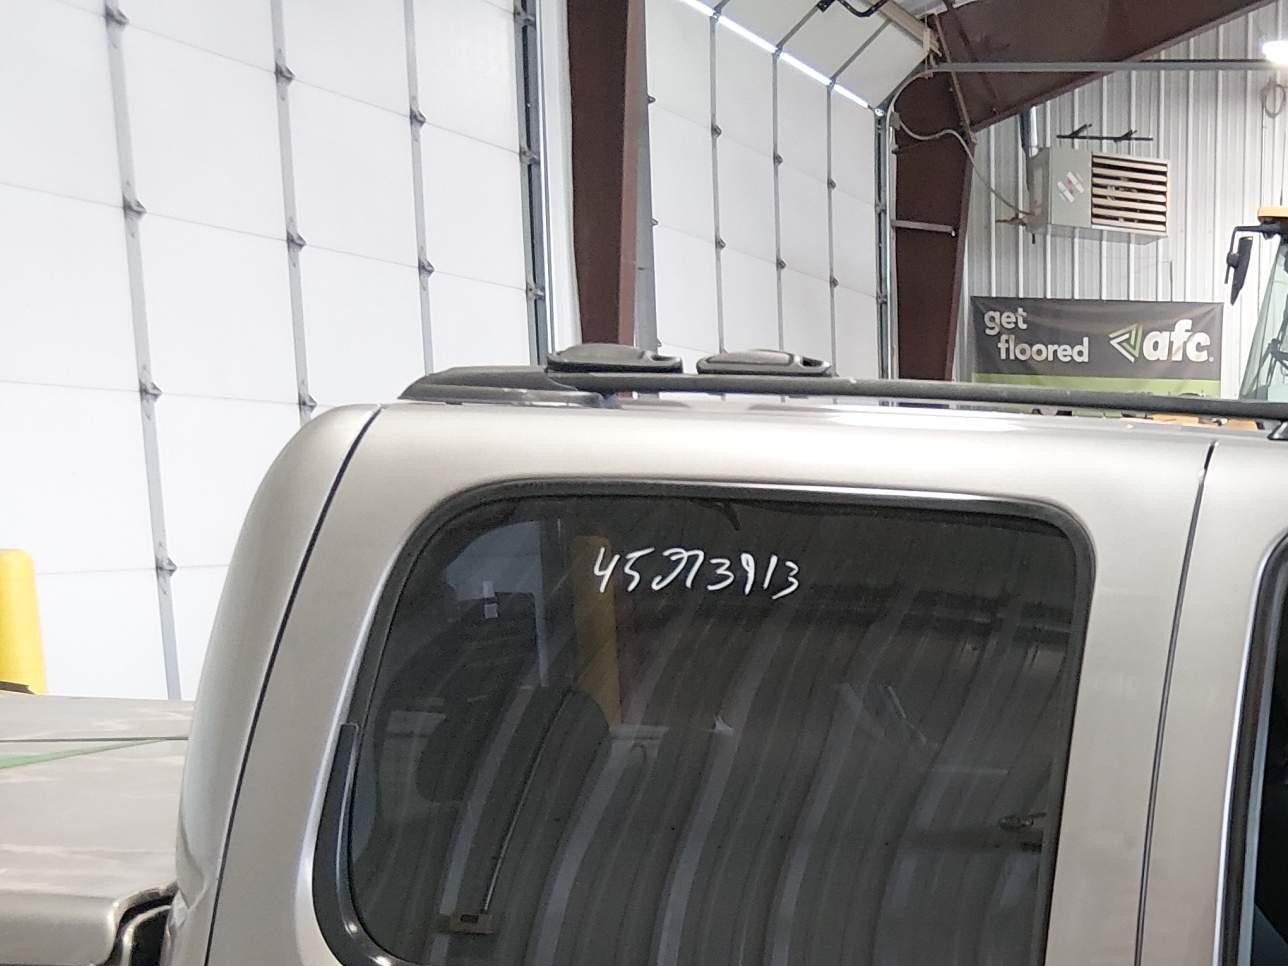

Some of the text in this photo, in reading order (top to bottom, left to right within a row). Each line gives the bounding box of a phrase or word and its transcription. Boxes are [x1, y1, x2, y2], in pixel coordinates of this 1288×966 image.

[983, 307, 1028, 336] get
[997, 334, 1090, 362] floored
[594, 547, 800, 600] 45273913
